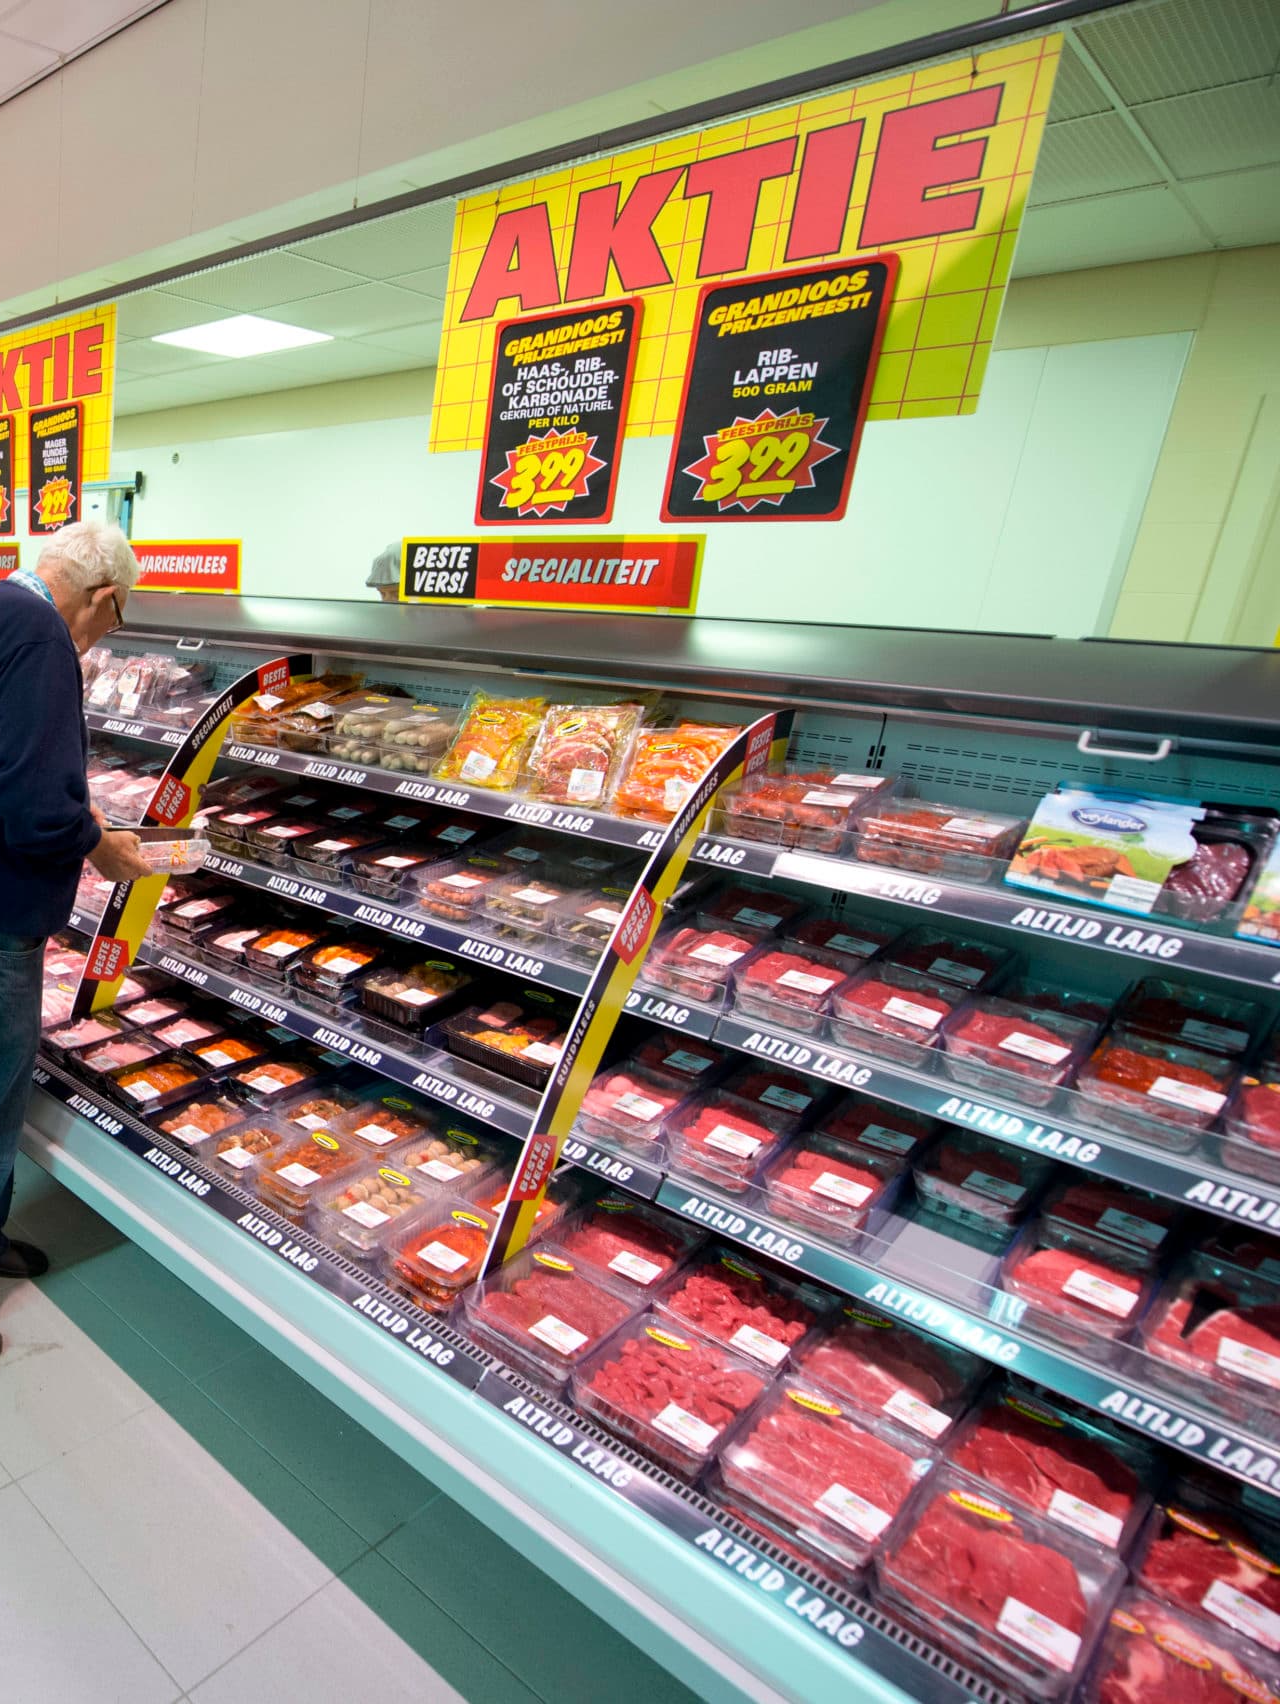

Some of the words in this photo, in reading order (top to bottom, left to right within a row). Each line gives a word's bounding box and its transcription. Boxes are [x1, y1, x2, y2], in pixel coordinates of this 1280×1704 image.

[460, 82, 1006, 322] AKTIE
[708, 270, 869, 326] GRANDIOOS
[718, 291, 872, 337] PRIJZENFEEST!
[505, 311, 622, 357] GRANDIOOS
[513, 329, 626, 367] PRIJZENFEEST!
[517, 363, 568, 380] HAAS-,
[575, 357, 606, 373] RIB-
[757, 348, 799, 366] RIB-
[502, 383, 522, 397] OF
[526, 371, 619, 393] SCHOUDER-
[732, 386, 759, 398] 500
[765, 381, 812, 395] GRAM
[733, 362, 818, 386] LAPPEN
[500, 407, 545, 421] GEKRUID
[547, 405, 561, 416] OF
[563, 400, 614, 415] NATUREL
[509, 386, 608, 409] KARBONADE
[528, 418, 550, 429] PER
[553, 415, 579, 427] KILO
[722, 414, 811, 440] FEESTPRIJS
[45, 438, 67, 448] MAGER
[519, 434, 586, 455] FEESTPRIJS
[43, 455, 67, 467] GEHAKT
[140, 556, 227, 575] VARKENSVLEES
[414, 546, 470, 570] BESTE
[502, 557, 660, 585] SPECIALITEIT
[415, 571, 469, 594] VERS!
[264, 667, 287, 686] BESTE
[103, 720, 124, 733] ALTIJD
[125, 723, 144, 736] LAAG
[191, 694, 233, 750] SPECIALITEIT
[228, 746, 256, 761] ALTIJD
[257, 750, 281, 766] LAAG
[750, 727, 773, 754] BESTE
[304, 762, 337, 778] ALTIJD
[337, 769, 367, 784] LAAG
[155, 778, 176, 815] BESTE
[165, 786, 185, 821] VERS!
[395, 781, 432, 799] ALTIJD
[433, 788, 470, 806] LAAG
[674, 771, 719, 843] RUNDVLEES
[504, 803, 552, 824] ALTIJD
[553, 811, 594, 832] LAAG
[220, 860, 243, 876] LAAG
[697, 842, 746, 865] LAAG
[267, 875, 298, 896] ALTIJD
[299, 884, 326, 904] LAAG
[880, 882, 942, 904] LAAG
[354, 905, 392, 928] ALTIJD
[393, 917, 425, 937] LAAG
[620, 893, 646, 946] BESTE
[626, 902, 652, 952] VERS!
[1011, 908, 1102, 940] ALTIJD
[1104, 926, 1183, 958] LAAG
[93, 940, 110, 975] BESTE
[104, 943, 122, 976] VERS!
[158, 956, 186, 974] ALTIJD
[184, 966, 208, 985] LAAG
[458, 940, 505, 963] ALTIJD
[506, 952, 544, 976] LAAG
[229, 988, 260, 1010] ALTIJD
[260, 1001, 287, 1022] LAAG
[642, 998, 690, 1024] LAAG
[313, 1028, 350, 1051] ALTIJD
[349, 1042, 382, 1066] LAAG
[556, 1001, 595, 1086] RUNDVLEES
[742, 1032, 812, 1065] ALTIJD
[812, 1055, 872, 1086] LAAG
[412, 1073, 457, 1100] ALTIJD
[457, 1092, 495, 1118] LAAG
[66, 1094, 95, 1119] ALTIJD
[95, 1112, 123, 1136] LAAG
[937, 1097, 1024, 1137] ALTIJD
[1026, 1125, 1101, 1162] LAAG
[144, 1147, 179, 1176] ALTIJD
[178, 1170, 211, 1198] LAAG
[519, 1141, 543, 1192] BESTE
[529, 1142, 551, 1191] VERS!
[587, 1155, 634, 1182] LAAG
[237, 1213, 280, 1247] ALTIJD
[279, 1239, 319, 1272] LAAG
[680, 1198, 748, 1235] ALTIJD
[748, 1225, 804, 1262] LAAG
[352, 1293, 408, 1333] ALTIJD
[406, 1327, 455, 1367] LAAG
[865, 1282, 947, 1328] ALTIJD
[946, 1319, 1021, 1361] LAAG
[1100, 1390, 1206, 1446] ALTIJD
[503, 1396, 572, 1446] ALTIJD
[571, 1439, 633, 1489] LAAG
[694, 1528, 785, 1592] ALTIJD
[783, 1587, 865, 1647] LAAG
